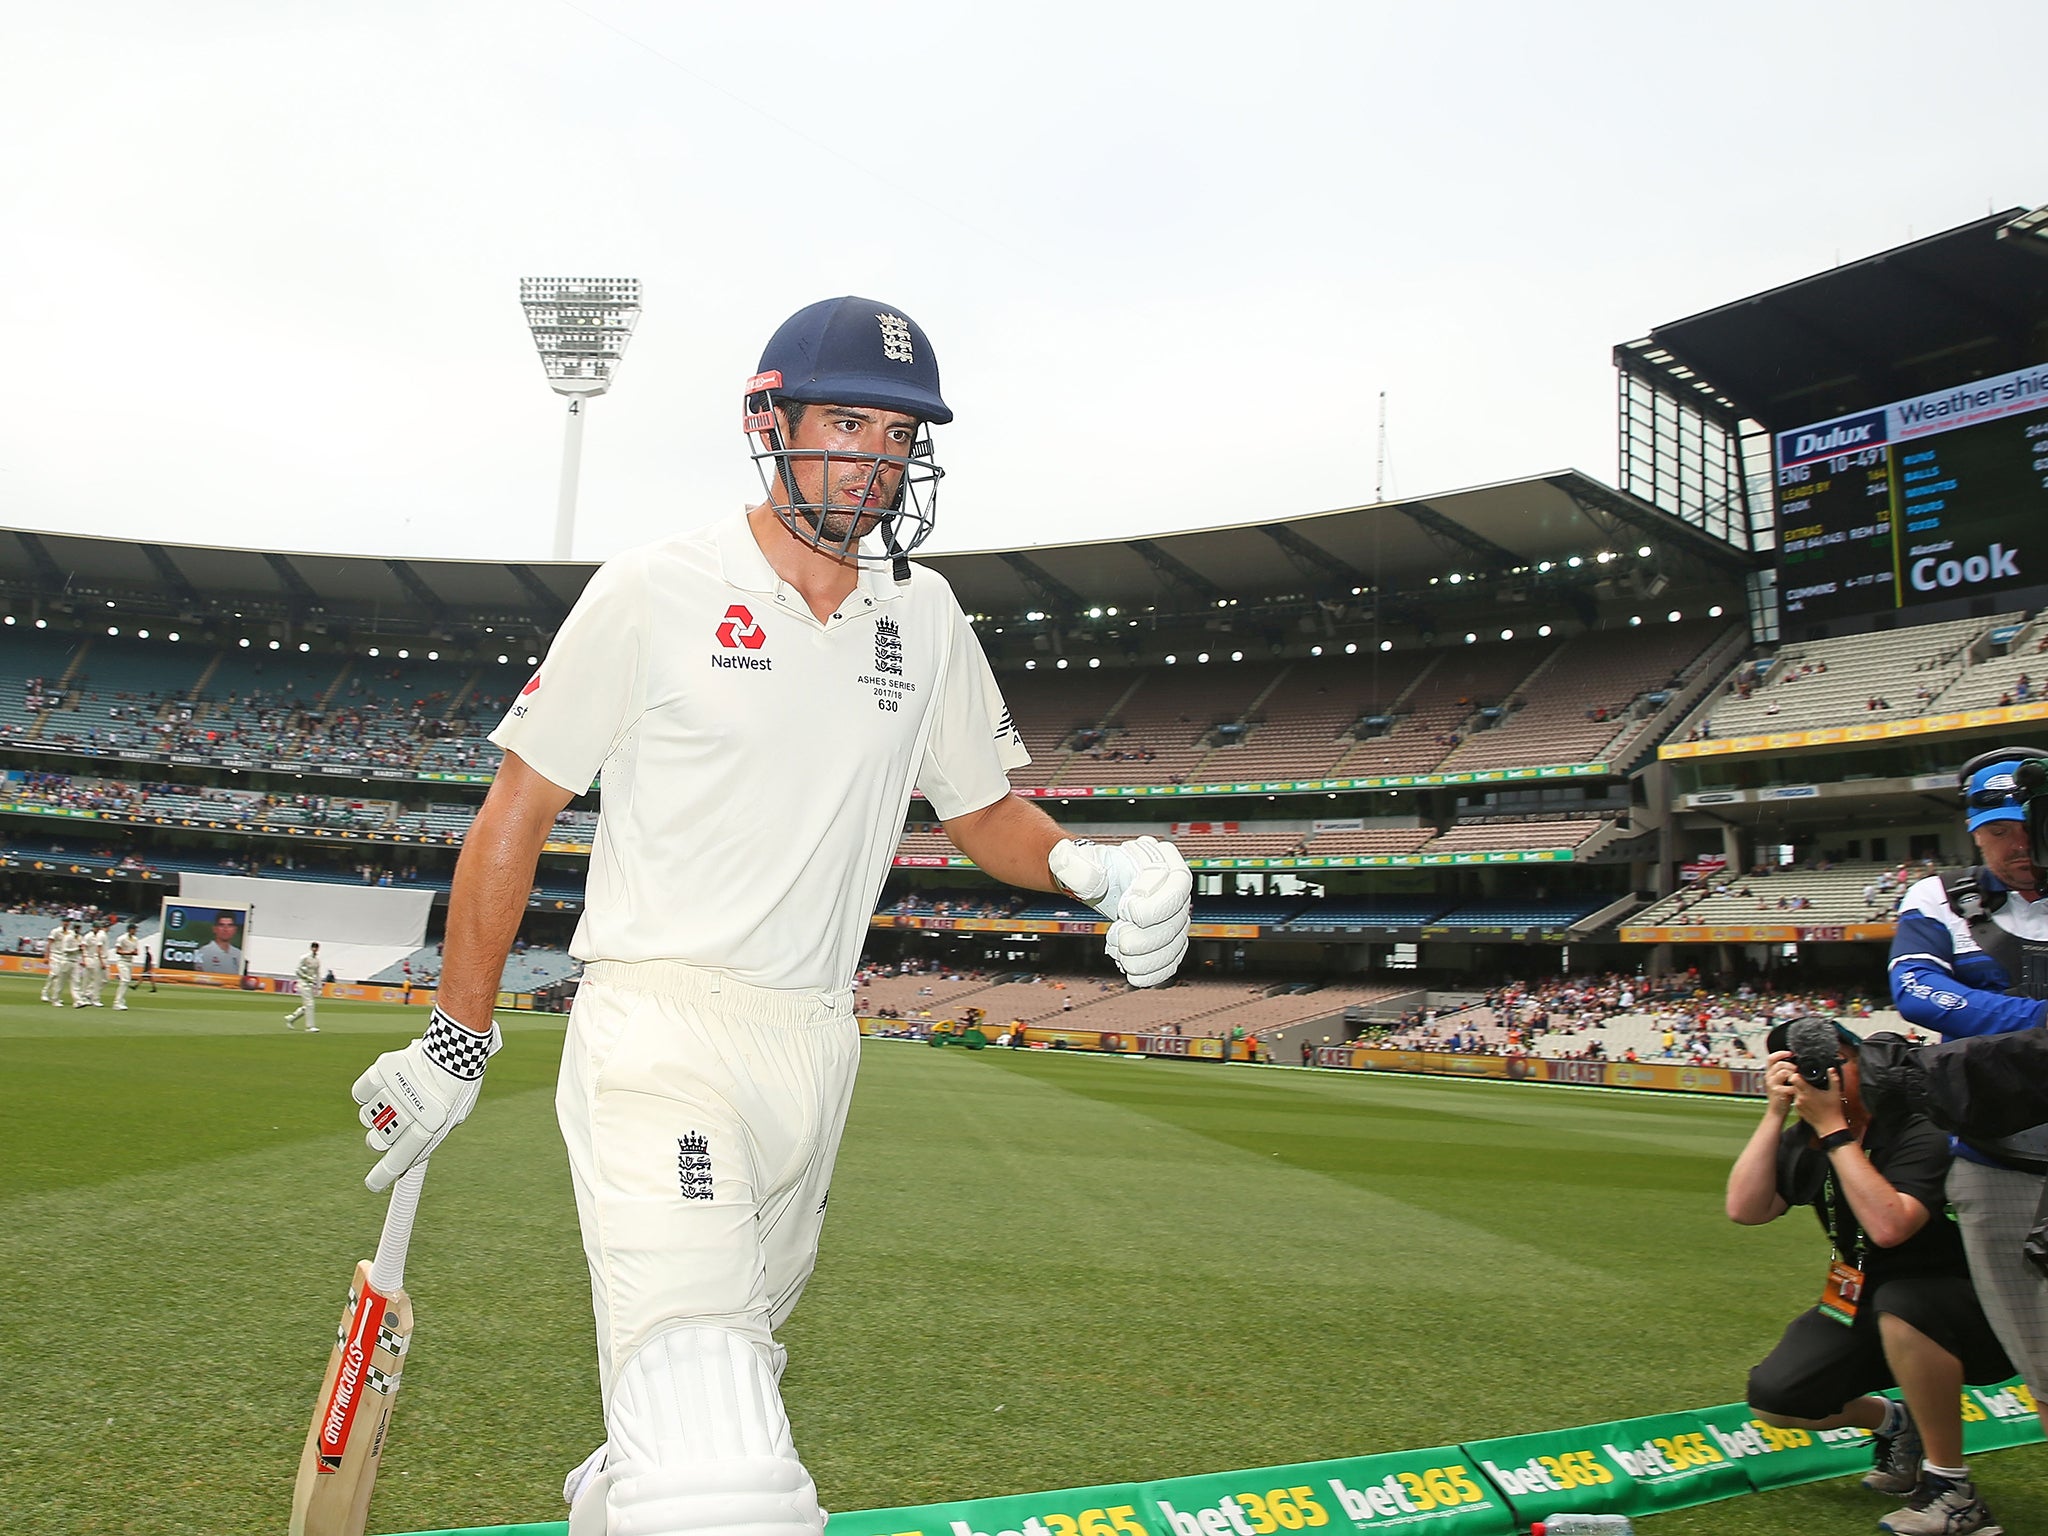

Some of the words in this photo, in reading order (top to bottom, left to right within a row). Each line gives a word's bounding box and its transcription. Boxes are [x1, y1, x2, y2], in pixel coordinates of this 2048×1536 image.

[568, 400, 580, 416] 4
[1795, 422, 1876, 458] Dulux
[1778, 465, 1811, 487] ENG
[1828, 446, 1888, 475] 10-491
[1910, 543, 2021, 591] Cook
[711, 654, 772, 671] NatWest
[857, 675, 886, 687] ASHES
[888, 679, 916, 692] SERIES
[873, 687, 903, 700] 2017/18
[878, 699, 898, 713] 630
[164, 947, 204, 964] Cook
[1137, 1036, 1191, 1055] WICKET
[1546, 1061, 1606, 1083] WICKET
[395, 1071, 426, 1113] PRESTIGE
[1601, 1432, 1724, 1477] bet365
[1481, 1450, 1615, 1496] bet365
[1327, 1465, 1484, 1520] bet365
[1157, 1485, 1330, 1536] bet365
